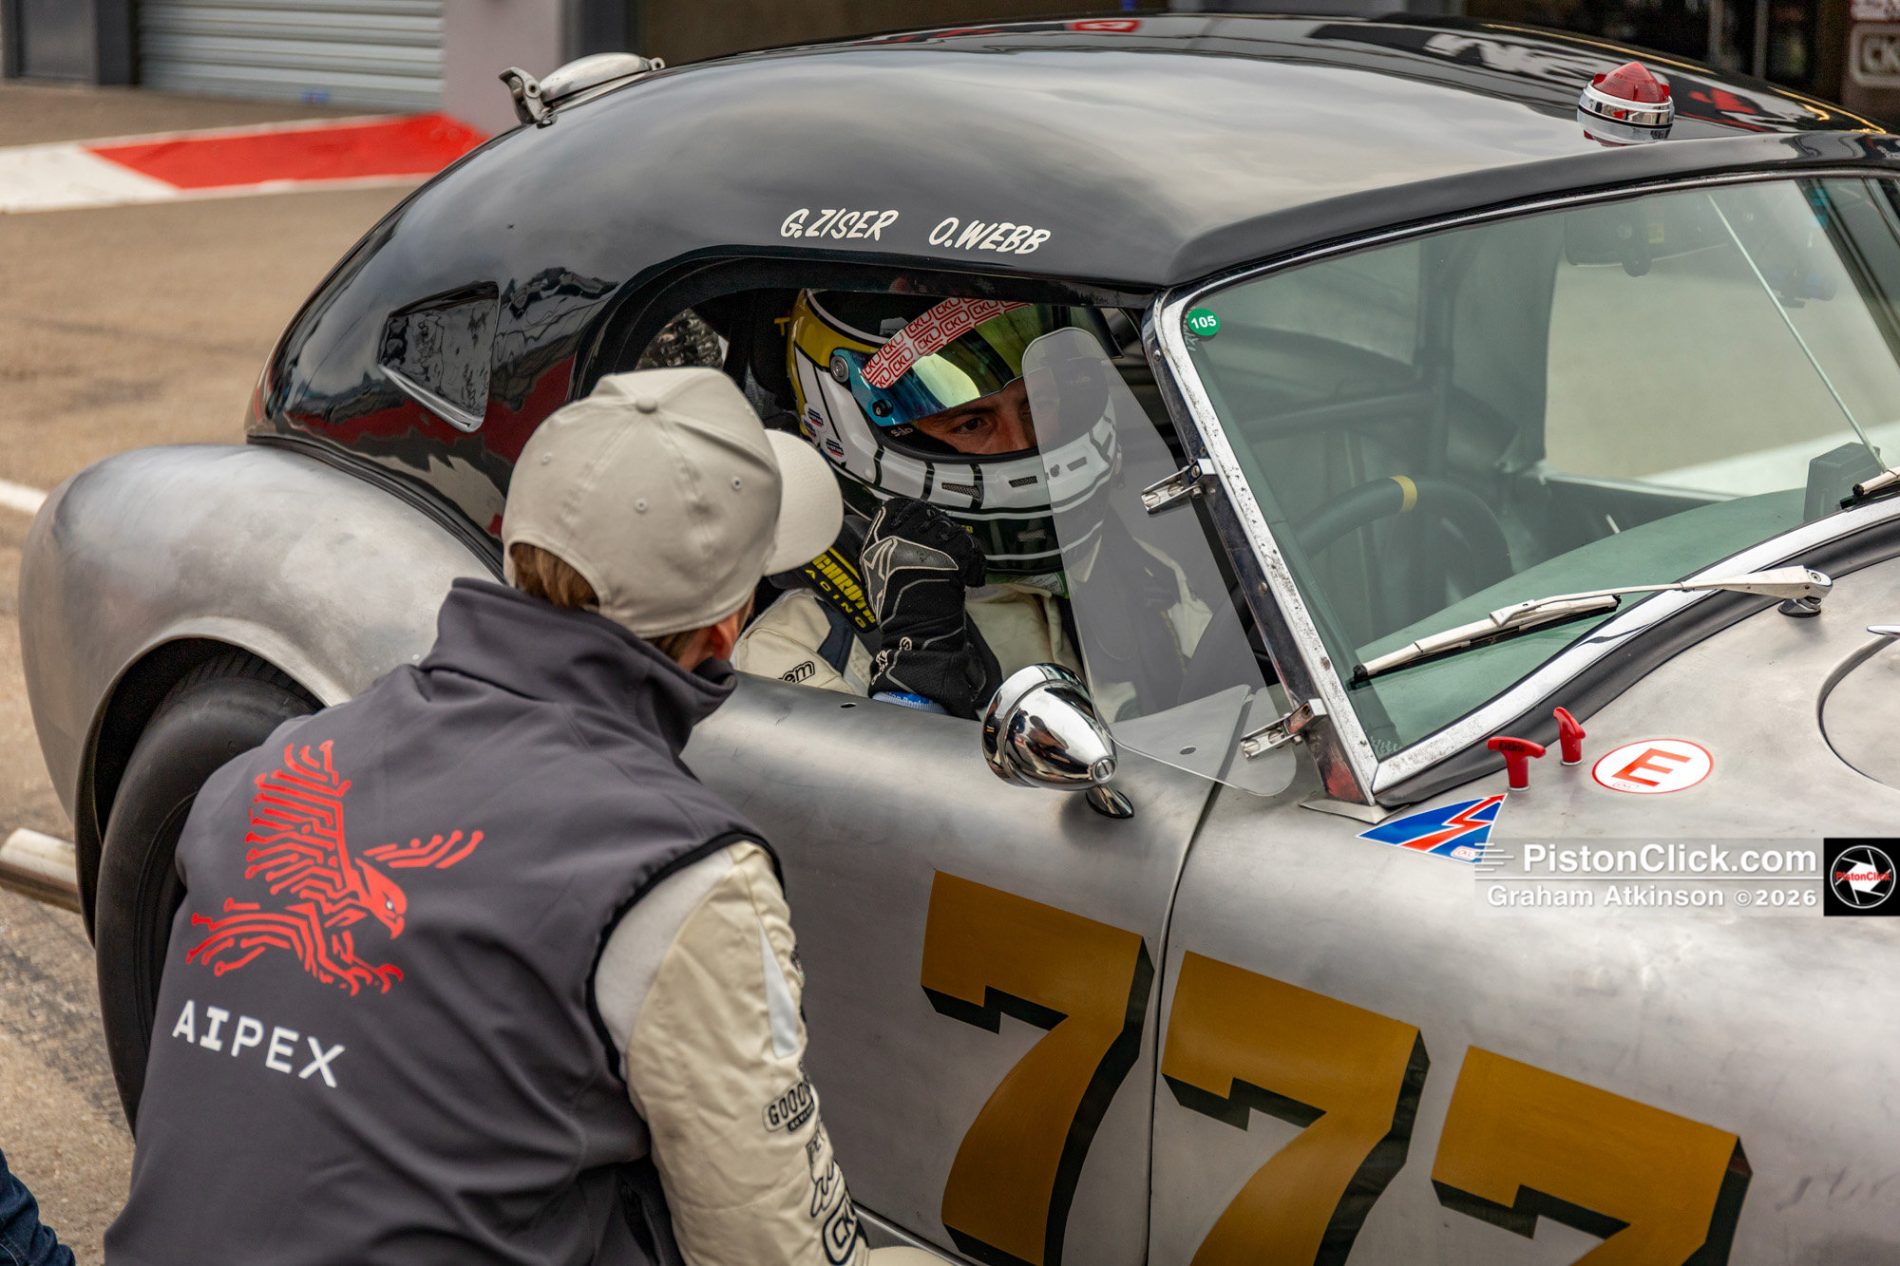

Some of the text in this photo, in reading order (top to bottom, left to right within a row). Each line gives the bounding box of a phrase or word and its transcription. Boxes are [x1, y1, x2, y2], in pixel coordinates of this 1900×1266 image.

[780, 208, 1051, 255] G.ZISER O.WEBB
[1191, 315, 1217, 329] 105
[1610, 748, 1693, 787] E
[172, 1000, 345, 1088] AIPEX
